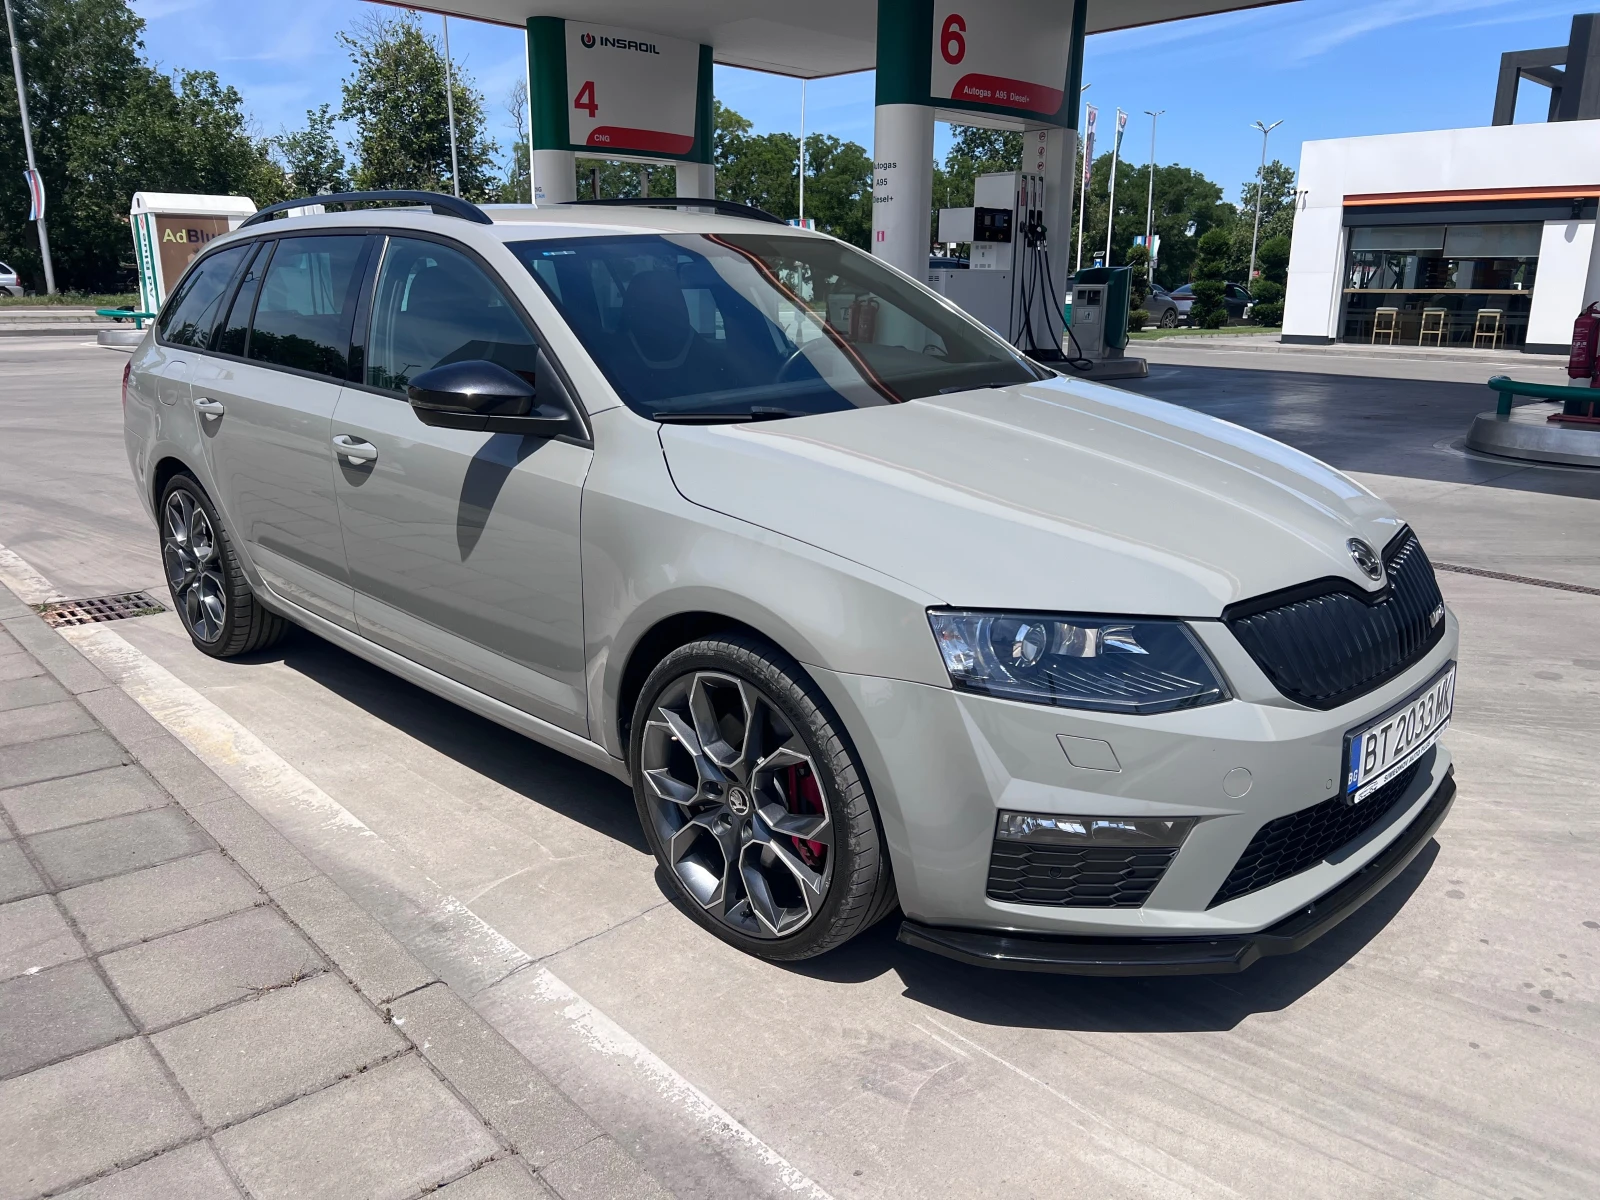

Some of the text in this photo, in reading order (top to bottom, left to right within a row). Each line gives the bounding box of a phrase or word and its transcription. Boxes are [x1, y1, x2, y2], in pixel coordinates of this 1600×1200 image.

[600, 36, 660, 55] INSAOIL
[940, 13, 967, 65] 6
[574, 81, 598, 118] 4
[963, 85, 1030, 104] Autogas A95 Diesel+
[594, 134, 610, 143] CNG
[875, 178, 888, 187] A95
[163, 229, 222, 244] AdBlu
[1363, 721, 1393, 777] BT
[1393, 692, 1434, 759] 2033
[1408, 747, 1422, 765] AUTO
[1348, 769, 1359, 785] BG
